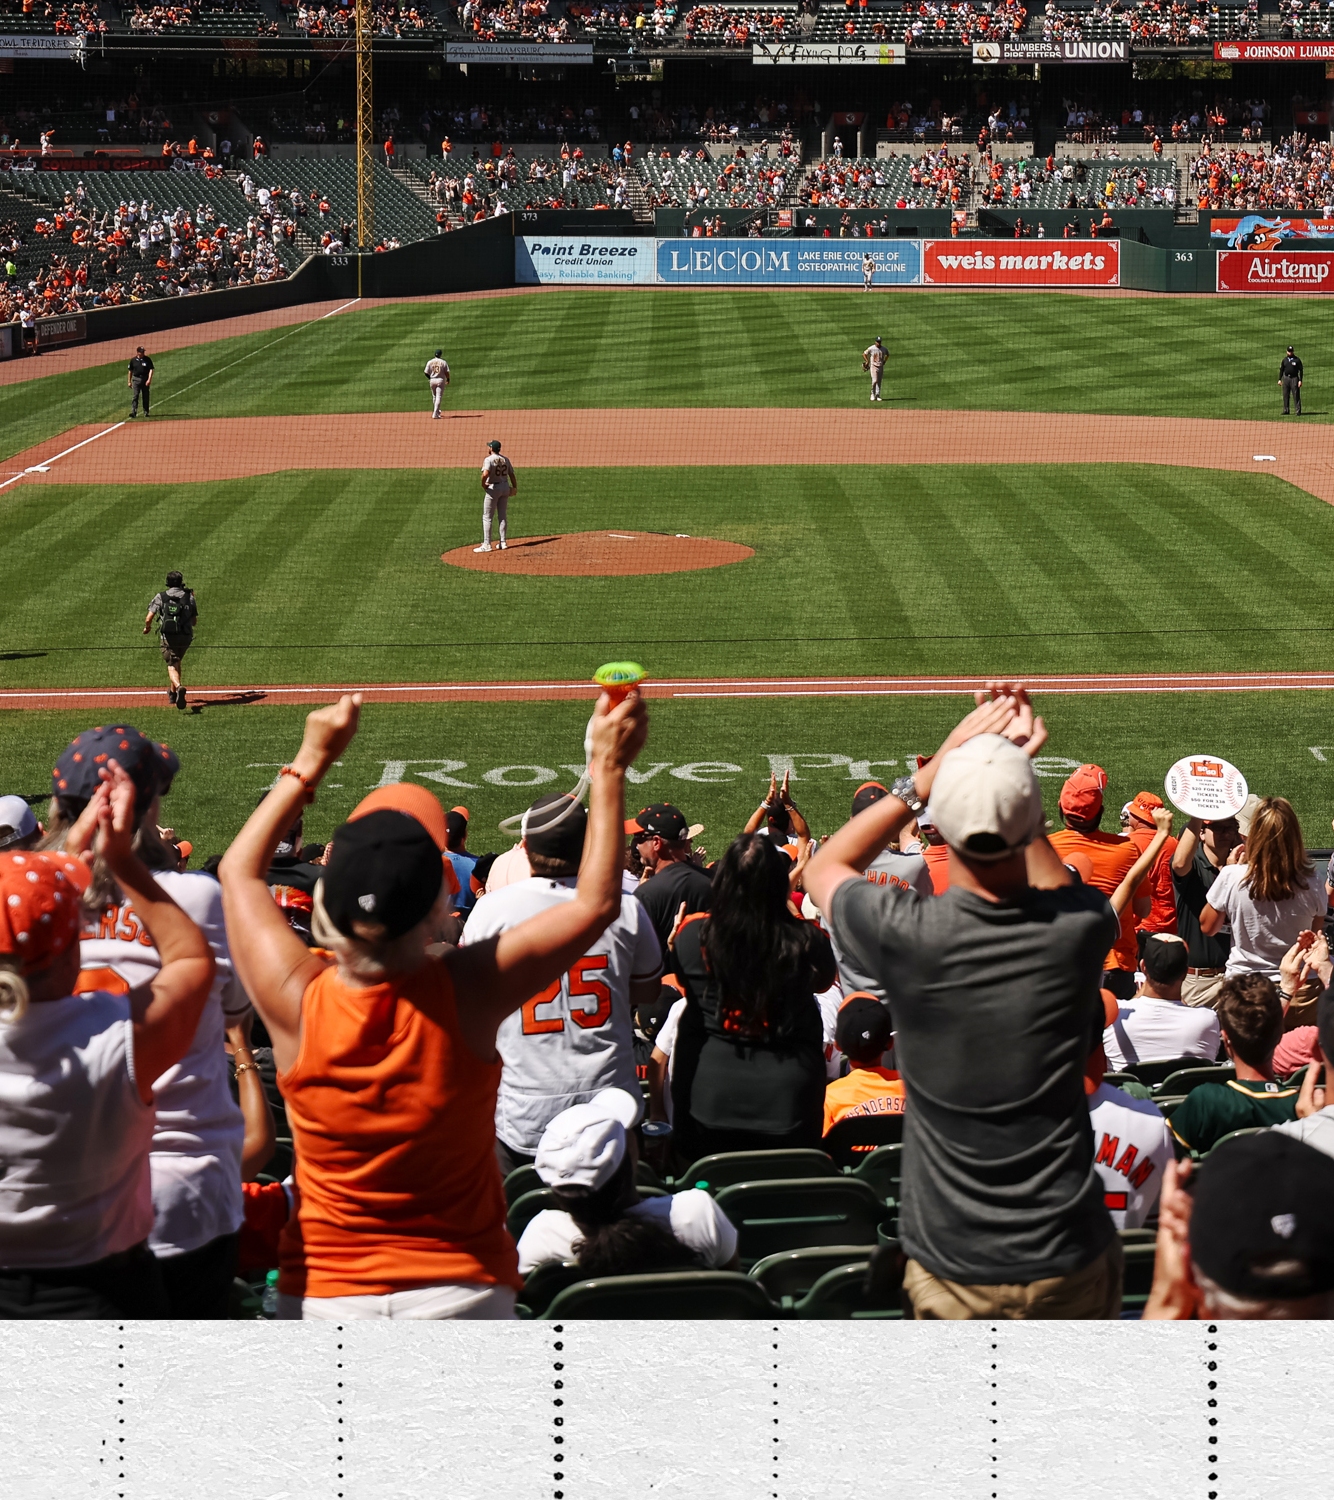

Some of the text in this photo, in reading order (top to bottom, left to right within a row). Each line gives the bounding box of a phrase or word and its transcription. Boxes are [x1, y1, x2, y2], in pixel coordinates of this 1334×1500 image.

[477, 45, 546, 57] WILLIAMSBURG
[838, 45, 867, 63] DOG
[1004, 43, 1053, 51] PLUMBERS
[1065, 42, 1124, 58] UNION
[1244, 45, 1295, 58] JOHNSON
[41, 160, 166, 170] COWSER'S CORRAL
[522, 212, 538, 222] 373
[530, 243, 638, 257] Point Breeze
[797, 251, 821, 260] LAKE
[823, 251, 842, 260] ERIE
[887, 252, 899, 260] OF
[331, 257, 348, 267] 333
[554, 257, 613, 266] Credit Union
[937, 251, 1105, 270] weis markets
[1174, 252, 1193, 262] 363
[797, 262, 906, 272] OSTEOPATHIC DICINE
[1248, 257, 1328, 283] Airtemp
[533, 270, 556, 280] Easy,
[559, 270, 594, 278] Reliable
[41, 320, 77, 336] DEFENDER ONE
[495, 464, 508, 477] 62
[760, 753, 1085, 782] Prie
[521, 953, 612, 1035] 25
[1095, 1132, 1155, 1190] MAN
